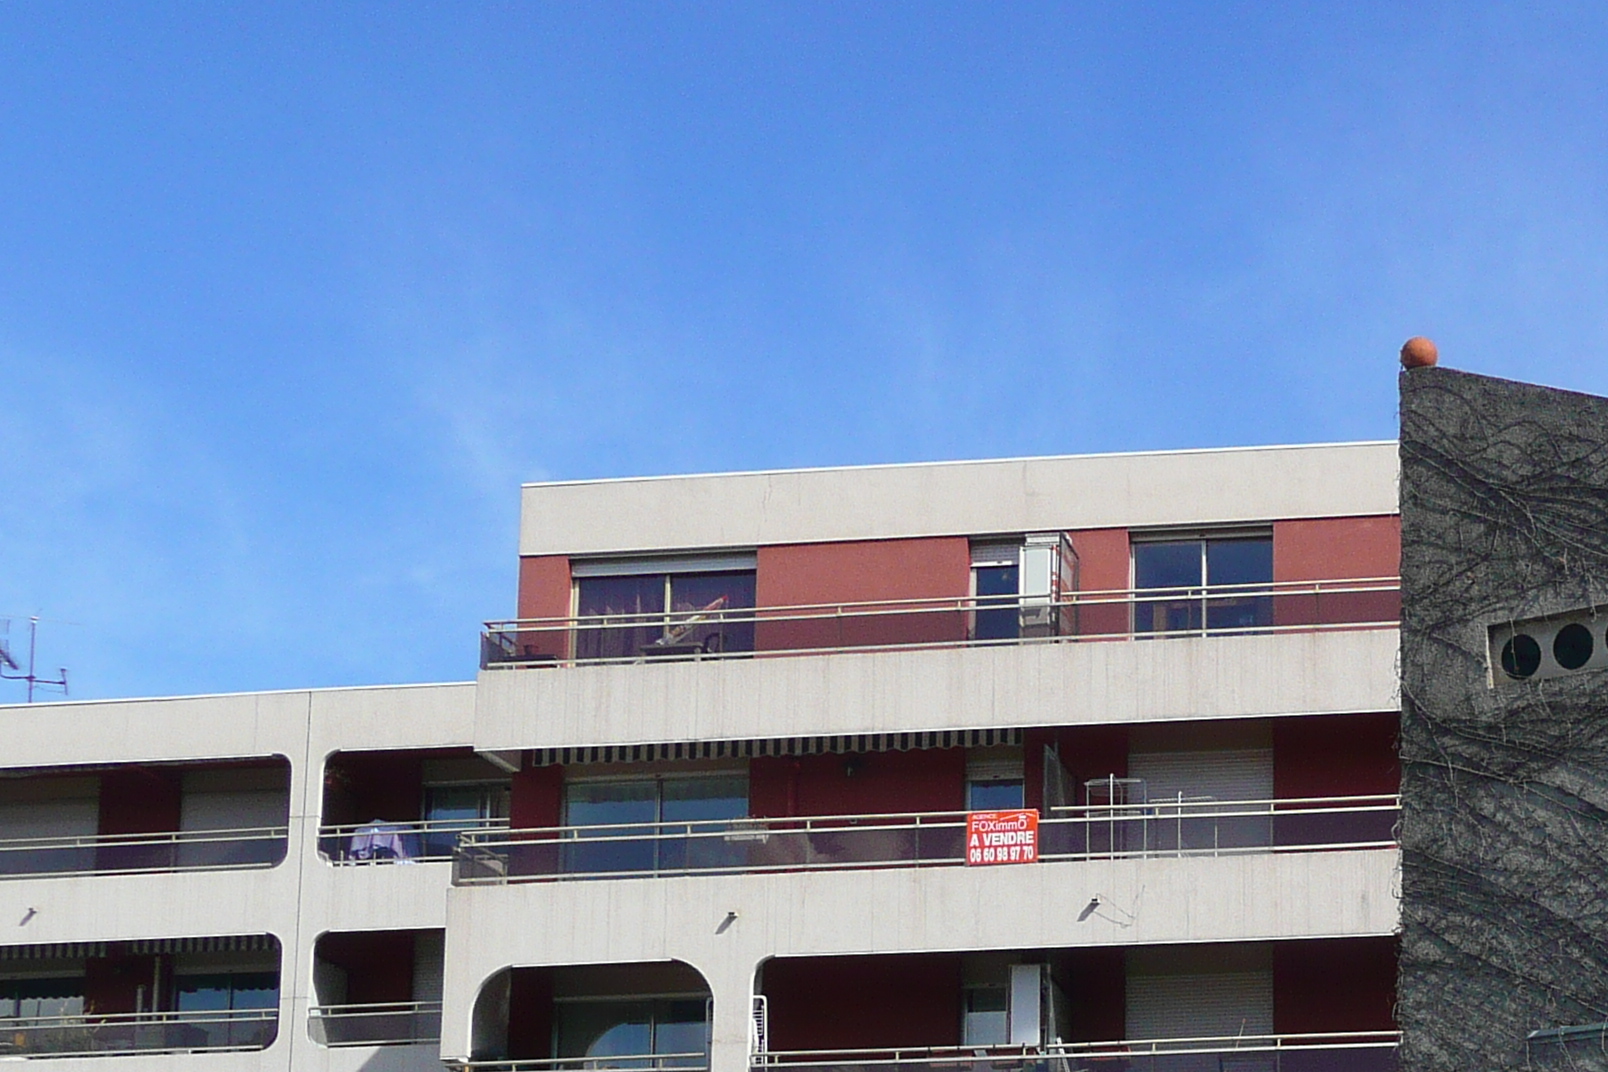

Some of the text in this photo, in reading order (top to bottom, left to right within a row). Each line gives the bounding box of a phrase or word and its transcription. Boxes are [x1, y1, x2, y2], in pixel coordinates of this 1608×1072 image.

[970, 831, 1035, 847] A VENDRE
[970, 847, 982, 863] 06
[983, 847, 995, 862] 60
[1009, 845, 1021, 861] 97
[1022, 845, 1034, 860] 70
